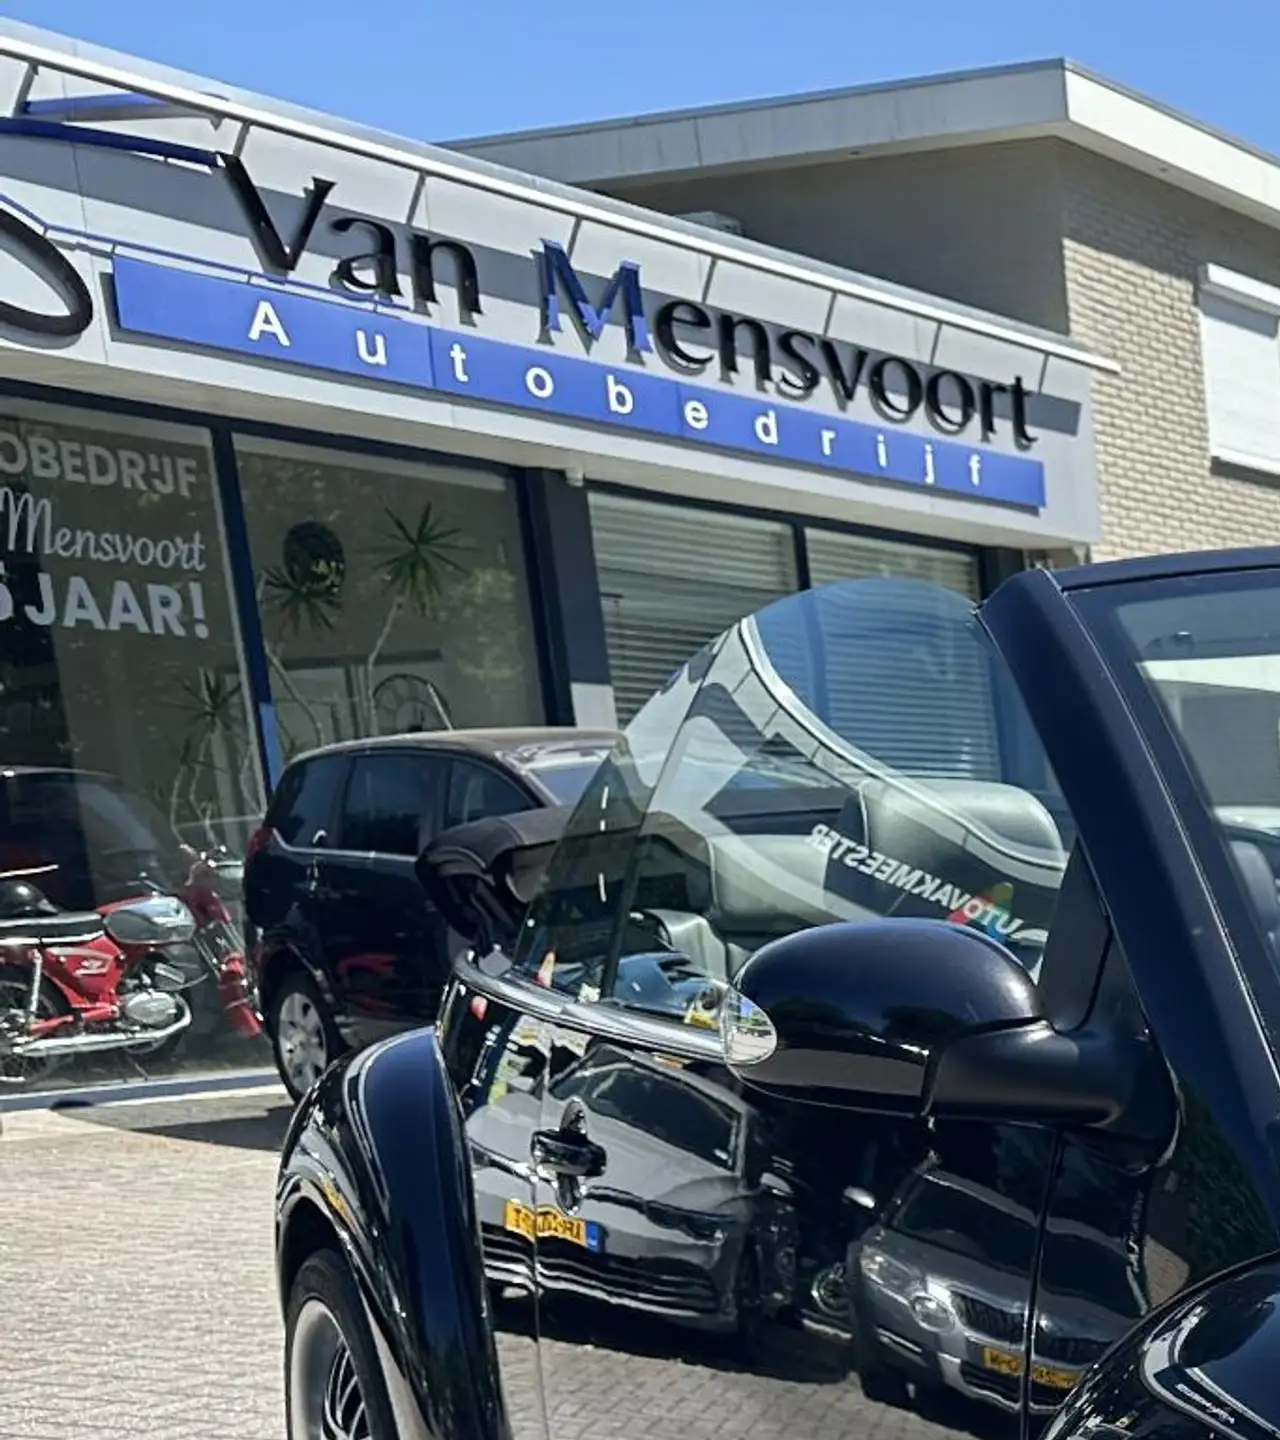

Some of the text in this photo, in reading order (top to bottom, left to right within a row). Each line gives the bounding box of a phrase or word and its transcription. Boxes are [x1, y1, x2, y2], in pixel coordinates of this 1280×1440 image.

[219, 151, 1040, 450] Van Mensvoort
[247, 299, 983, 485] Autobedrijf
[24, 572, 209, 640] JAAR!
